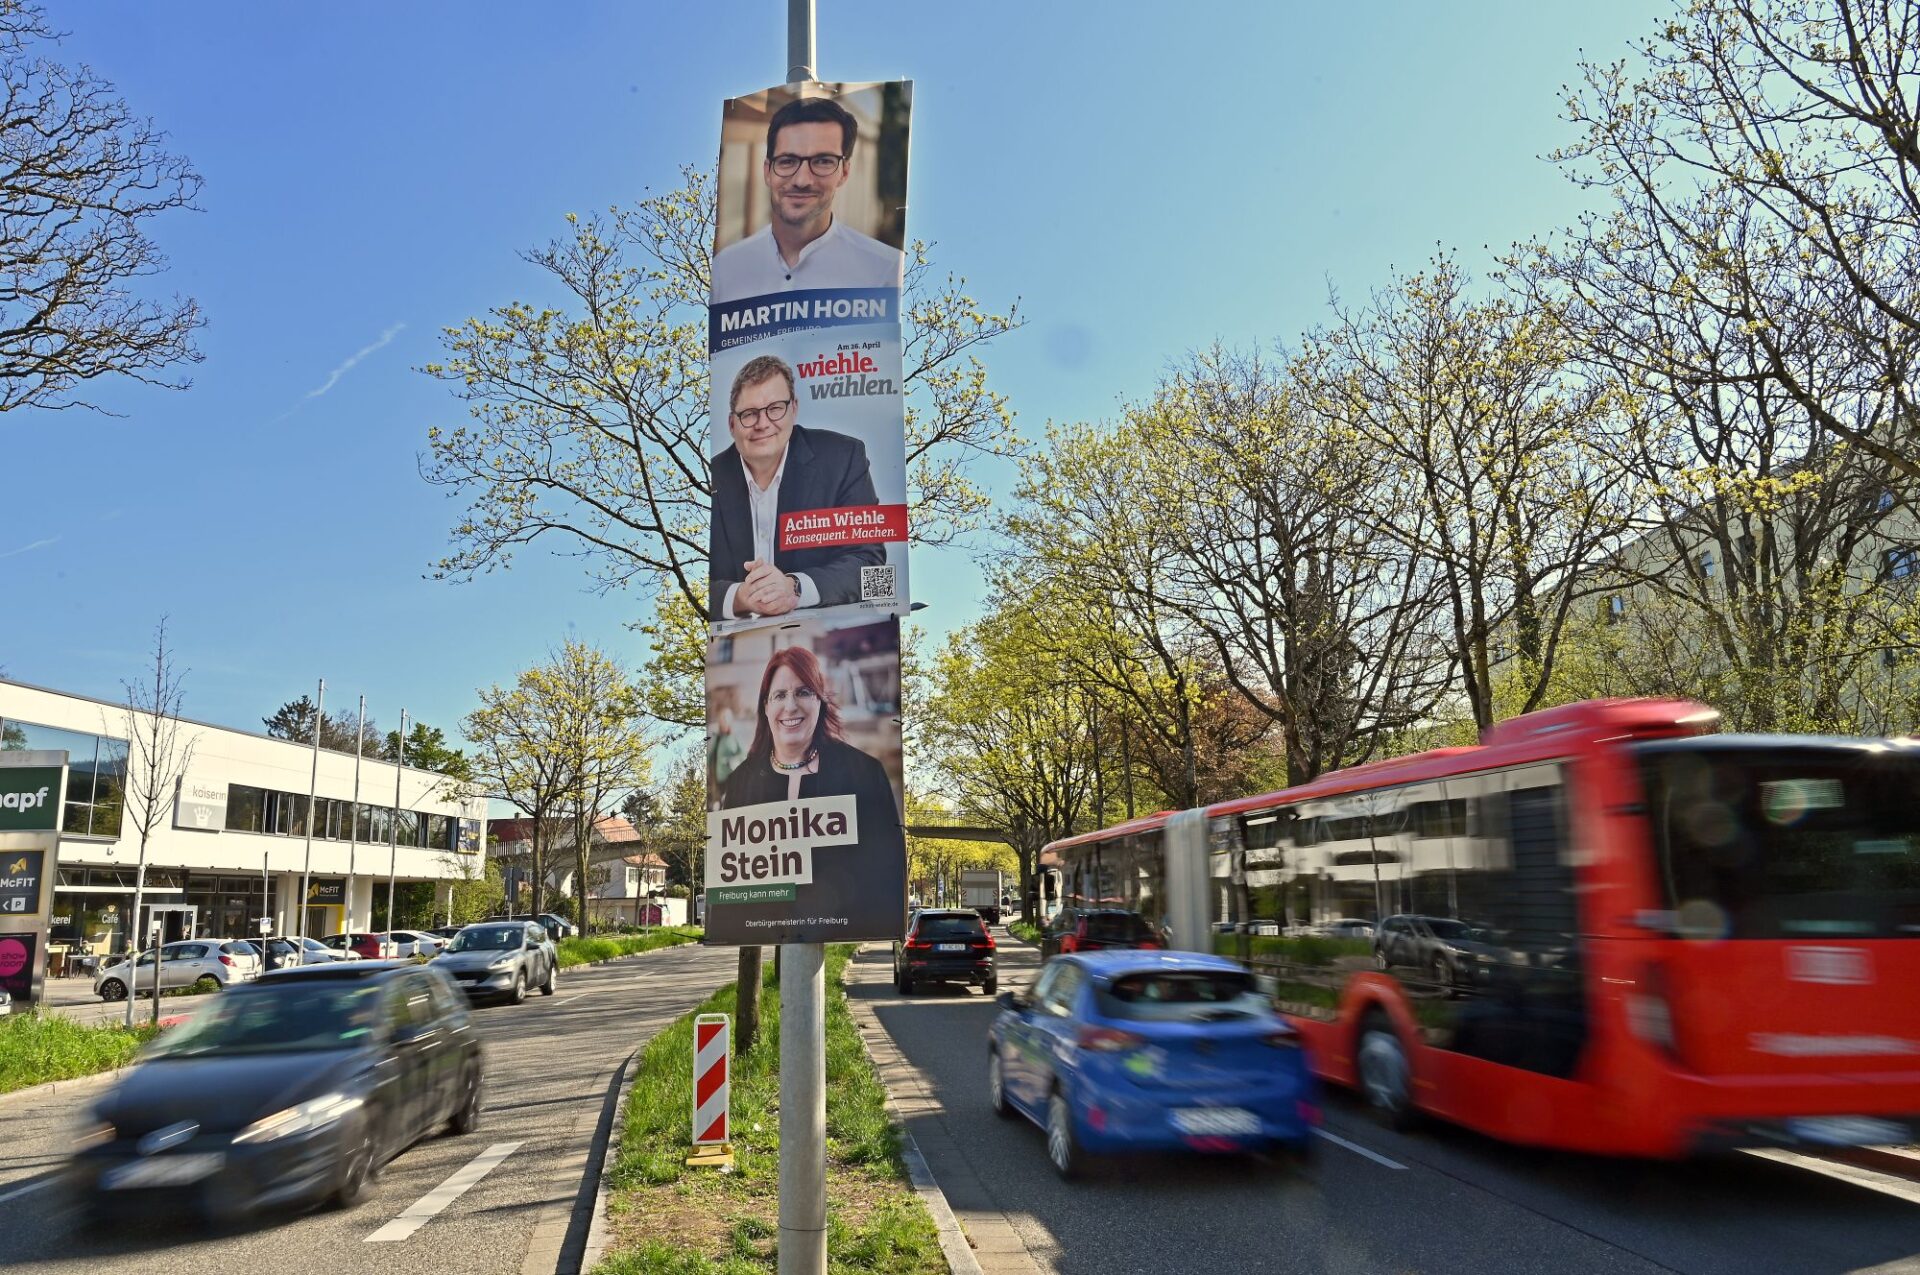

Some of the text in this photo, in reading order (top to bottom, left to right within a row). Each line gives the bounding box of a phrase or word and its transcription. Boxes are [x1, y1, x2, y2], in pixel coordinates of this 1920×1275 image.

[721, 299, 886, 332] MARTIN HORN
[721, 331, 771, 347] GEMEINSAM
[862, 341, 881, 350] April
[797, 351, 878, 379] wiehle.
[810, 374, 898, 400] wählen.
[785, 510, 885, 532] Achim Wiehle
[785, 526, 897, 545] Konsequent. Machen.
[721, 806, 848, 848] Monika
[720, 845, 803, 883] Stein
[0, 877, 36, 888] McFIT
[320, 886, 340, 894] McFIT
[719, 888, 790, 901] Freiburg kann mehr
[15, 900, 22, 908] P
[102, 913, 119, 924] Café
[745, 916, 848, 928] Oberbürgermeisterin für Freiburg
[2, 952, 25, 960] show
